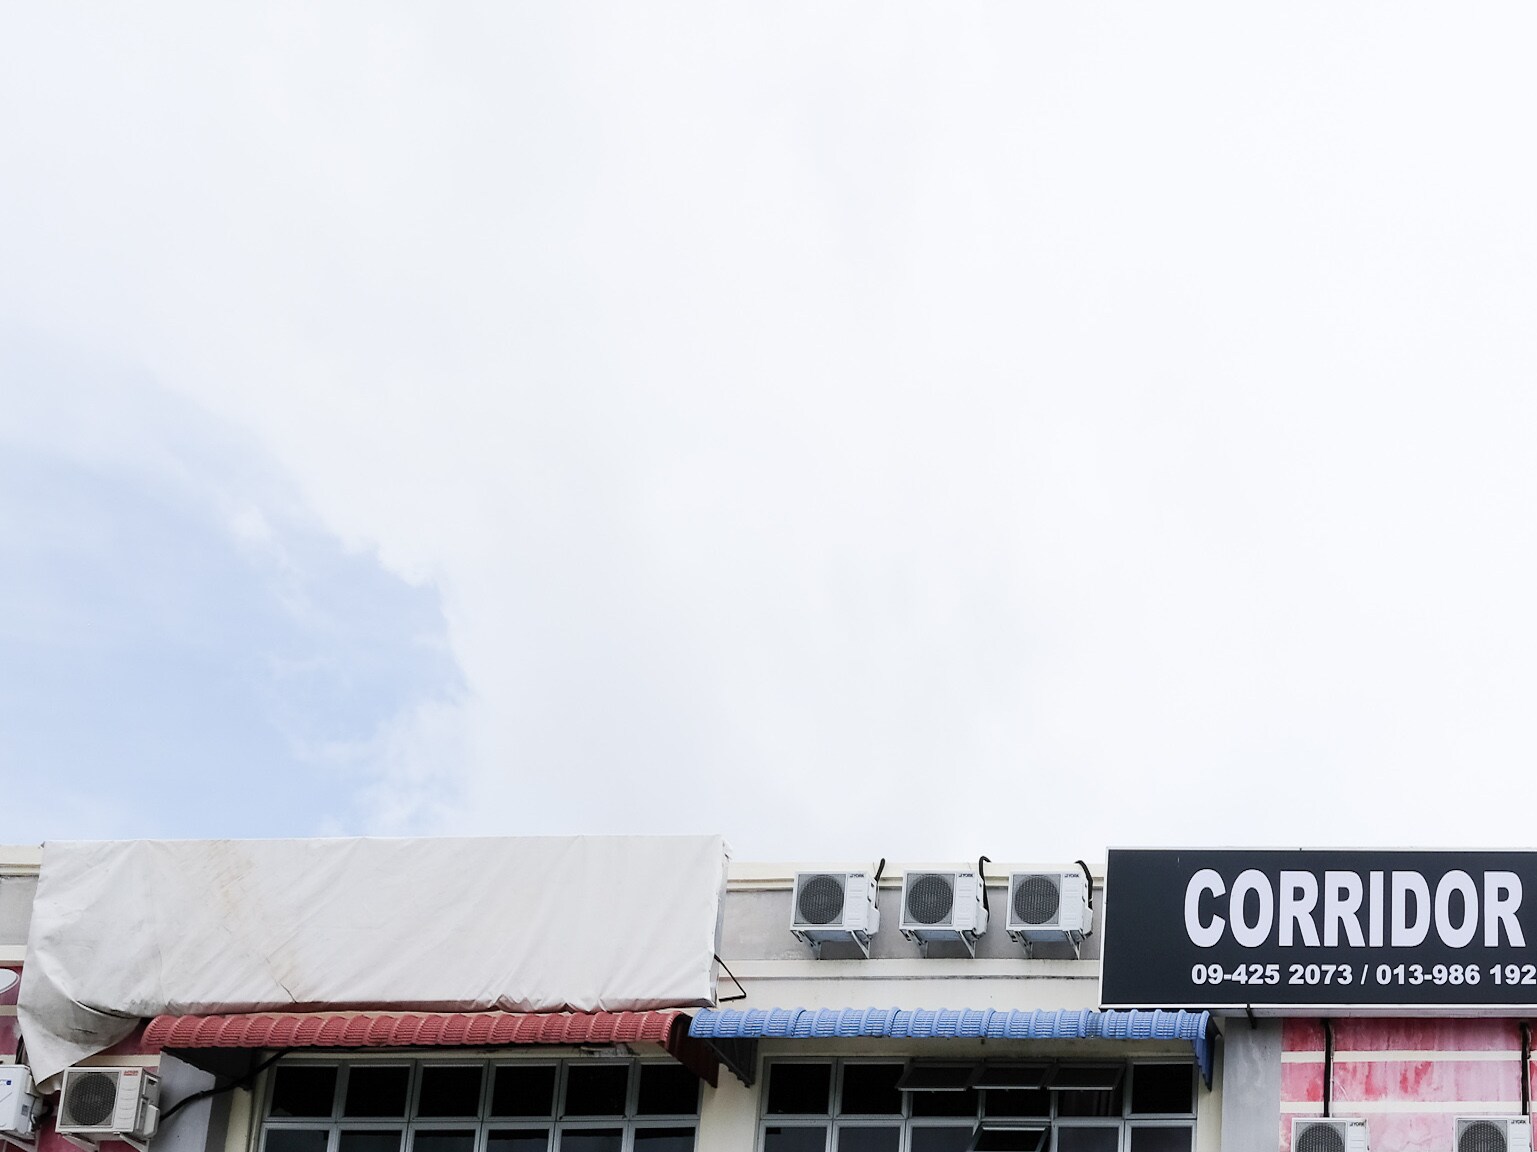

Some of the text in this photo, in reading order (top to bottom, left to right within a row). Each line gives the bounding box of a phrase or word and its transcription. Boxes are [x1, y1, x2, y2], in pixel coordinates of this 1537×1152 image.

[1184, 868, 1527, 949] CORRIDOR
[1191, 963, 1280, 986] 09-425
[1288, 963, 1353, 986] 2073
[1360, 964, 1368, 985] /
[1376, 963, 1480, 986] 013-986
